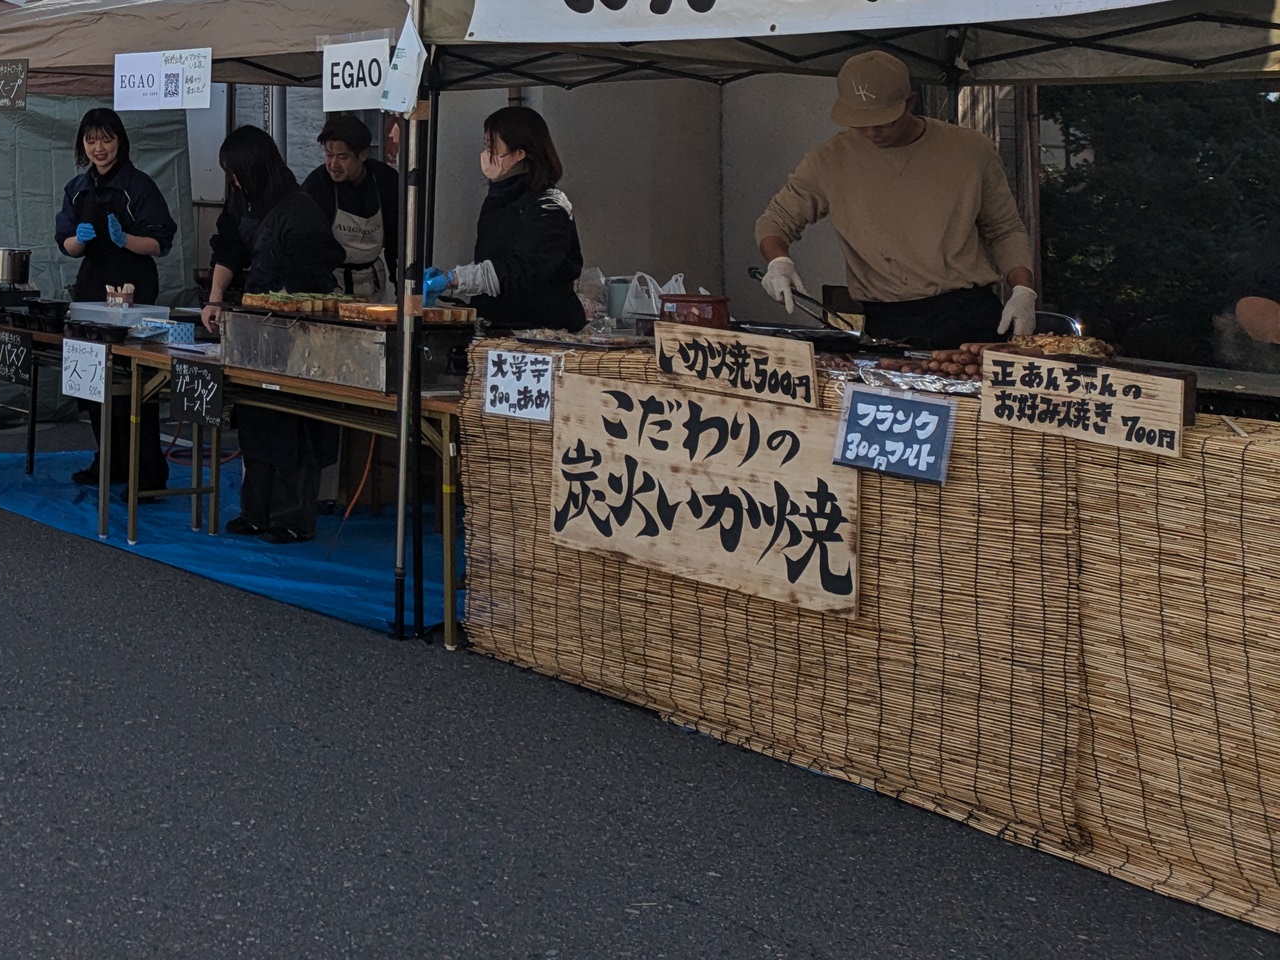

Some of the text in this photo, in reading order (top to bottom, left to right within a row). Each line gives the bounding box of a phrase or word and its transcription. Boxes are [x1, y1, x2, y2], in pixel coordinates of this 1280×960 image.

[120, 73, 155, 89] EGAO
[330, 58, 382, 90] EGAO
[0, 343, 27, 367] パスタ
[69, 359, 102, 383] スープ
[491, 352, 550, 384] 大学芋
[176, 375, 218, 401] ガーリック
[989, 358, 1143, 400] 正あんちゃんの
[184, 397, 211, 417] トースト
[856, 402, 939, 440] フランク
[993, 389, 1177, 451] お好み焼き 700円
[601, 389, 801, 469] こだわりの
[885, 439, 936, 471] フルト
[554, 438, 854, 596] 炭火いか焼
